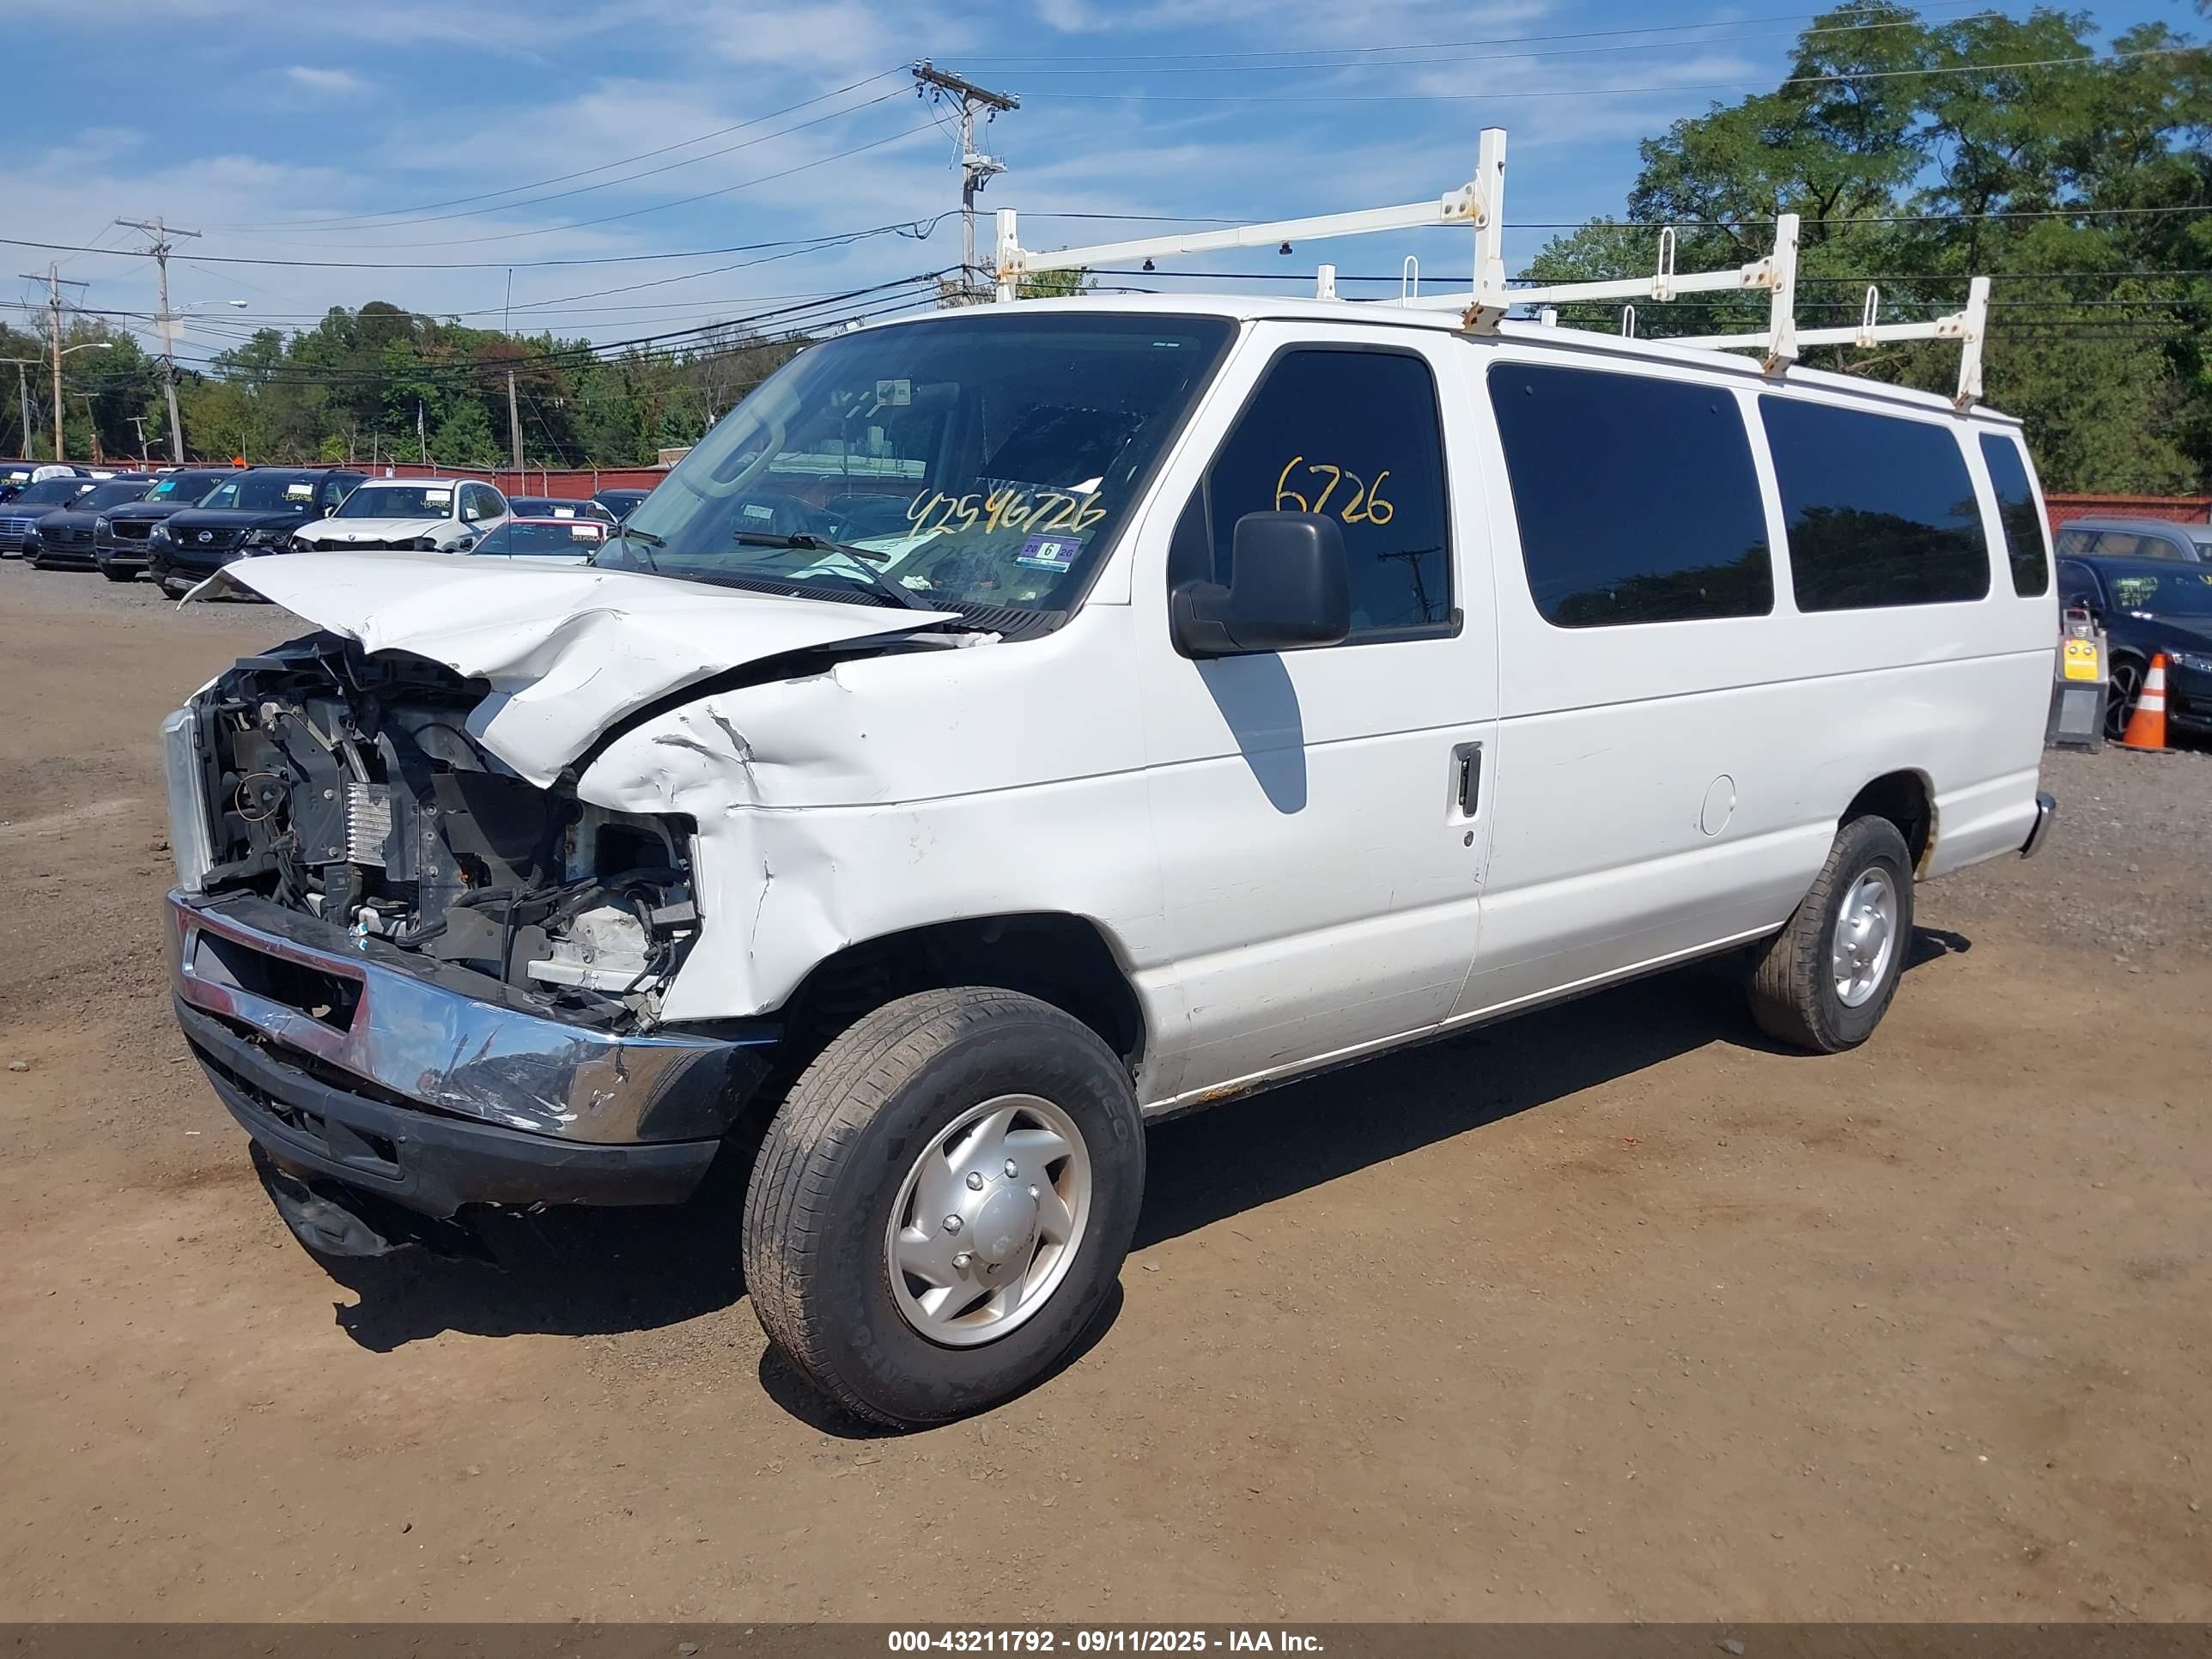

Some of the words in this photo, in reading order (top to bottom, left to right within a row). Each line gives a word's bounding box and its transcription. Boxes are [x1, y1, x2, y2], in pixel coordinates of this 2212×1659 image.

[1275, 455, 1394, 526] 6726
[1024, 544, 1038, 554] 20
[1044, 544, 1054, 556] 6
[1059, 549, 1073, 557] 26
